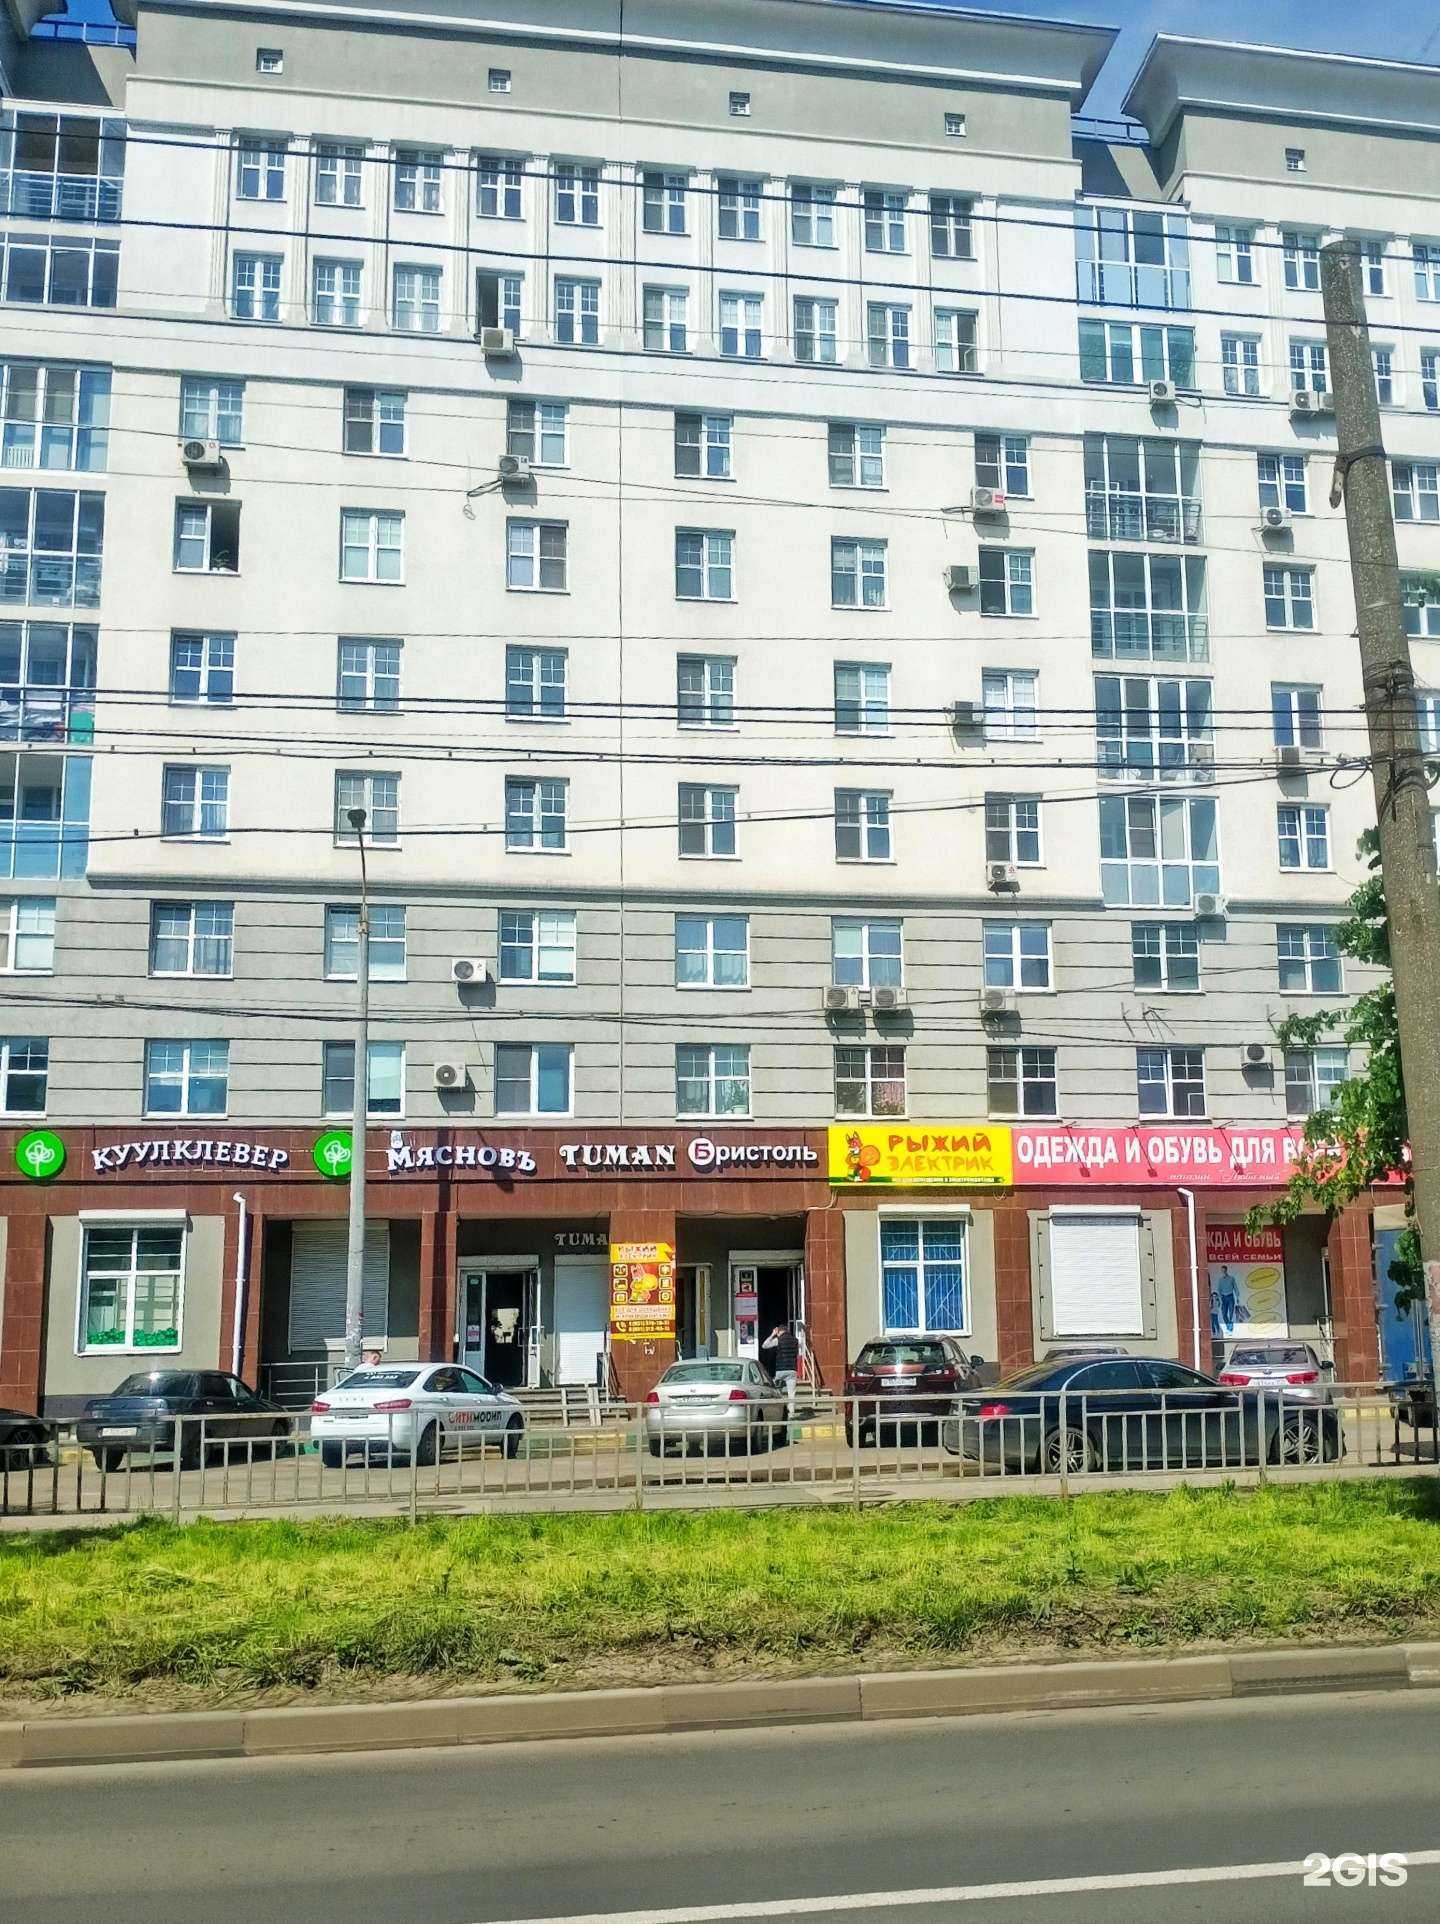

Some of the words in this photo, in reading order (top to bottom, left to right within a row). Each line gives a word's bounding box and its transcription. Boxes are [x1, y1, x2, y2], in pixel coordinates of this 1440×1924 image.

[688, 1137, 818, 1166] Бристоль
[888, 1133, 992, 1153] РЫЖИЙ
[1017, 1135, 1120, 1168] ОДЕЖДА
[1126, 1136, 1140, 1163] И
[1147, 1135, 1222, 1164] ОБУВЬ
[1229, 1136, 1276, 1169] ДЛЯ
[91, 1140, 288, 1170] КУУЛКЛЕВЕР
[559, 1144, 676, 1166] TUMAN
[886, 1155, 994, 1172] ЭЛЕКТРИК
[1234, 1232, 1242, 1248] И
[1243, 1253, 1282, 1261] СЕМЬИ
